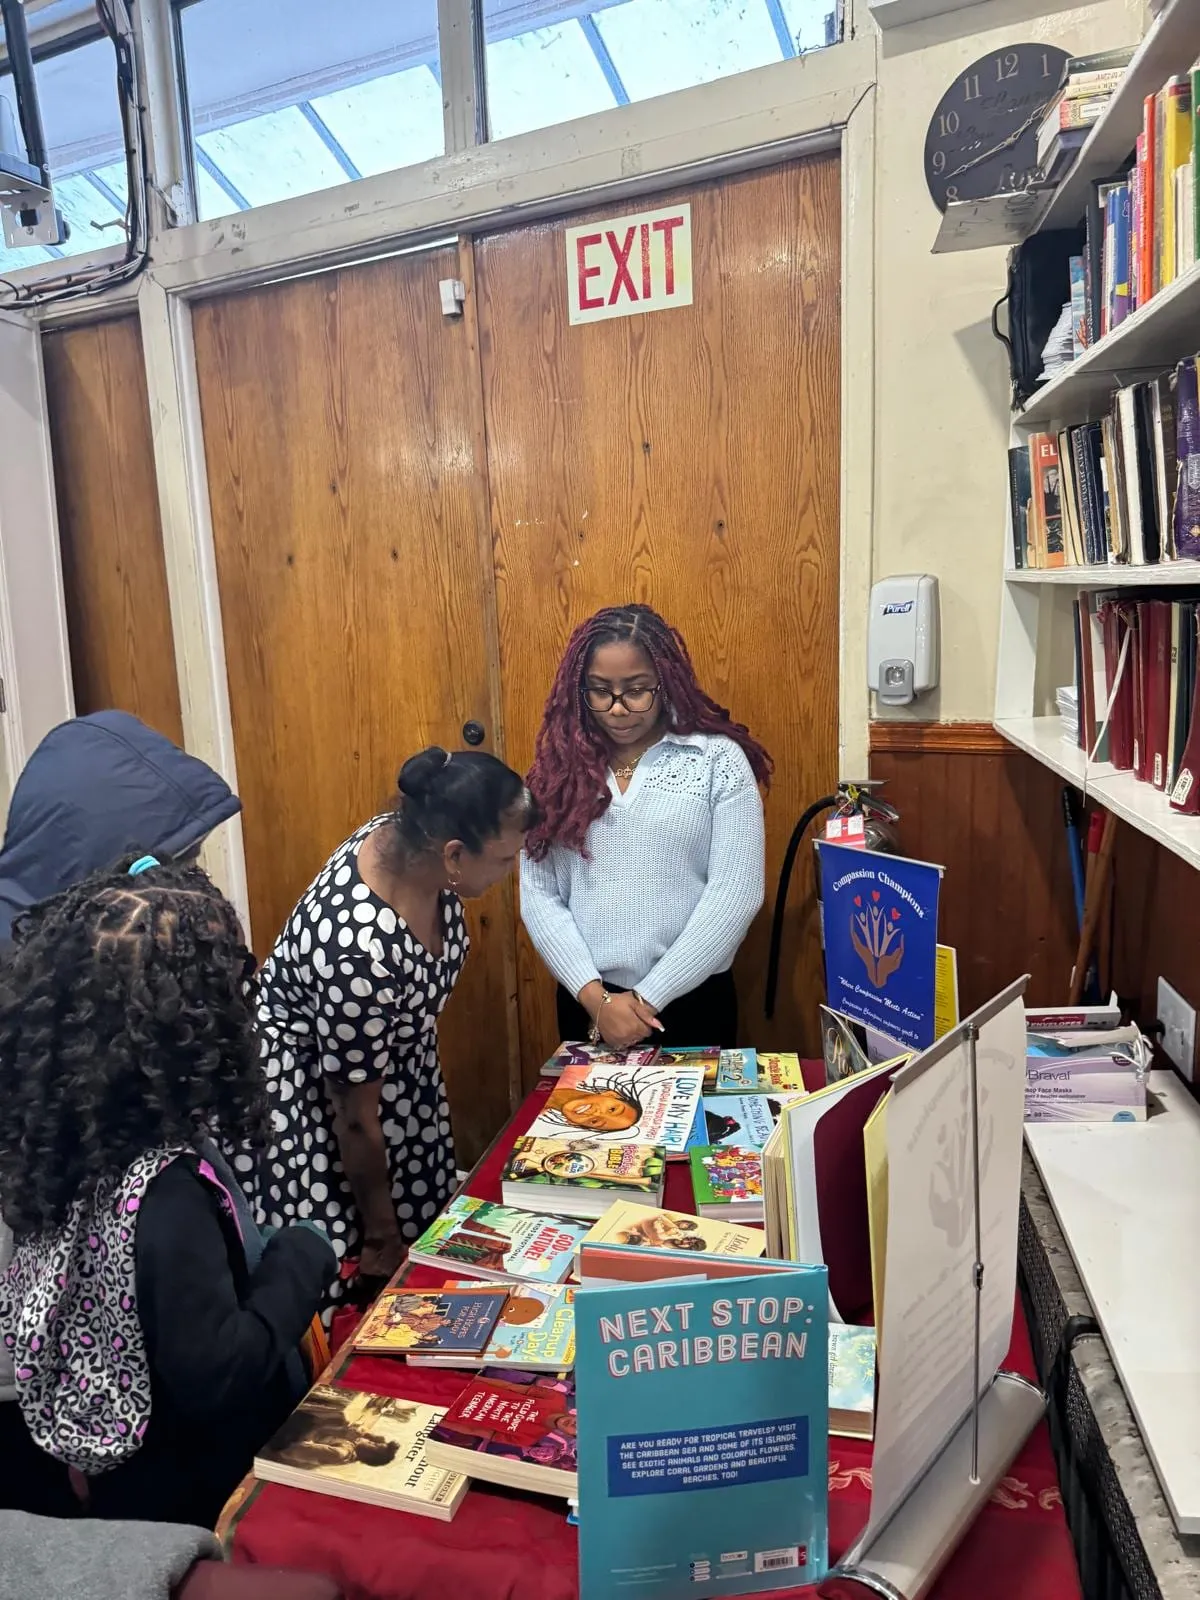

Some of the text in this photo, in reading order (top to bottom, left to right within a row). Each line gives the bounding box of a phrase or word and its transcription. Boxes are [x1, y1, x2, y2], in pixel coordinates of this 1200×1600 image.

[995, 53, 1019, 82] 12
[1040, 54, 1051, 78] 1
[963, 74, 982, 102] 11
[939, 110, 960, 138] 10
[932, 151, 946, 175] 9
[576, 216, 684, 311] EXIT
[832, 868, 925, 919] Compassion Champions
[673, 1077, 699, 1100] LOVE
[667, 1104, 691, 1120] MY
[656, 1121, 688, 1147] HAIR!
[522, 1226, 560, 1261] NATURE!
[552, 1233, 575, 1252] GOD
[543, 1309, 575, 1357] Cleanup
[599, 1297, 814, 1344] NEXT STOP:
[608, 1332, 808, 1378] CARIBBEAN
[472, 1393, 499, 1422] AMERICAN
[489, 1400, 509, 1420] NORTH
[500, 1402, 520, 1423] TO THE
[526, 1410, 539, 1422] THE
[620, 1423, 796, 1450] ARE YOU READY FOR TROPICAL TRAVELS? VISIT
[620, 1452, 634, 1460] THE
[636, 1448, 679, 1459] CARIBBEAN
[681, 1446, 697, 1455] SEA
[698, 1445, 715, 1453] AND
[717, 1441, 738, 1451] SOME
[740, 1440, 750, 1448] OF
[751, 1437, 763, 1446] ITS
[622, 1461, 636, 1469] SEE
[639, 1459, 665, 1468] EXOTIC
[667, 1455, 701, 1465] ANIMALS
[703, 1454, 719, 1462] AND
[721, 1449, 758, 1460] COLORFUL
[631, 1454, 787, 1478] EXPLORE CORAL GARDENS AND BEAUTIFUL
[721, 1470, 738, 1480] TOO!
